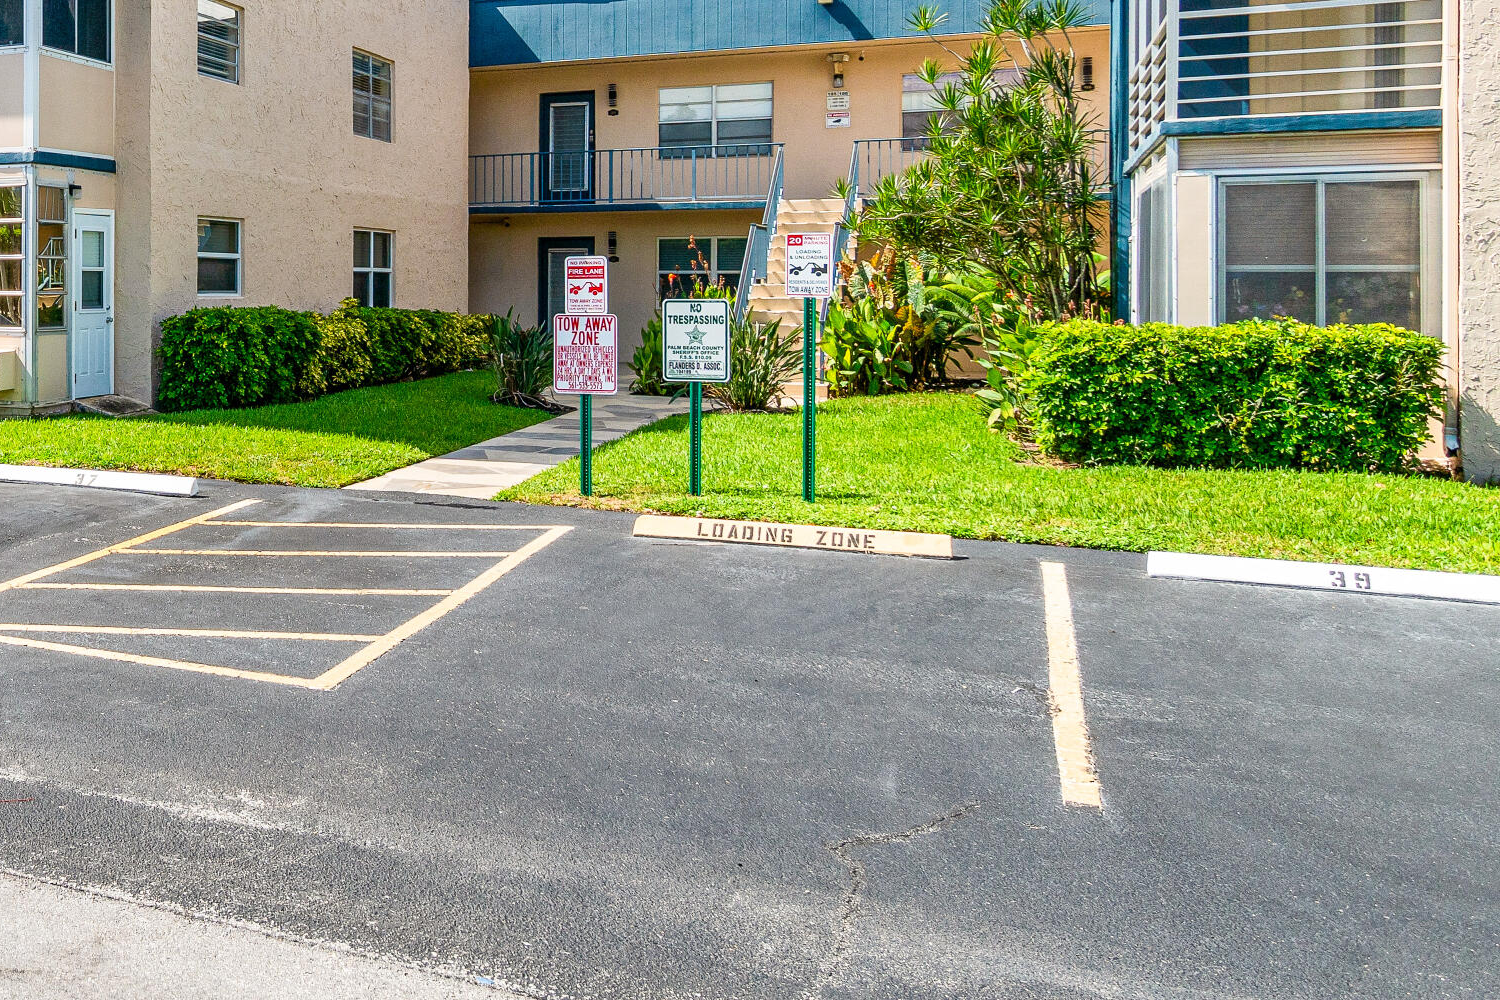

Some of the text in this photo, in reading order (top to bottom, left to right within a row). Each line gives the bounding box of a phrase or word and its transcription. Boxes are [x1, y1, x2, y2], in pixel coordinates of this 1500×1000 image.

[690, 304, 702, 312] NO
[558, 317, 613, 331] TOW AWAY
[668, 316, 724, 324] TRESPASSING
[571, 331, 600, 345] ZONE
[74, 473, 98, 486] 37
[698, 522, 876, 549] LOADING ZONE
[1329, 570, 1371, 590] 39
